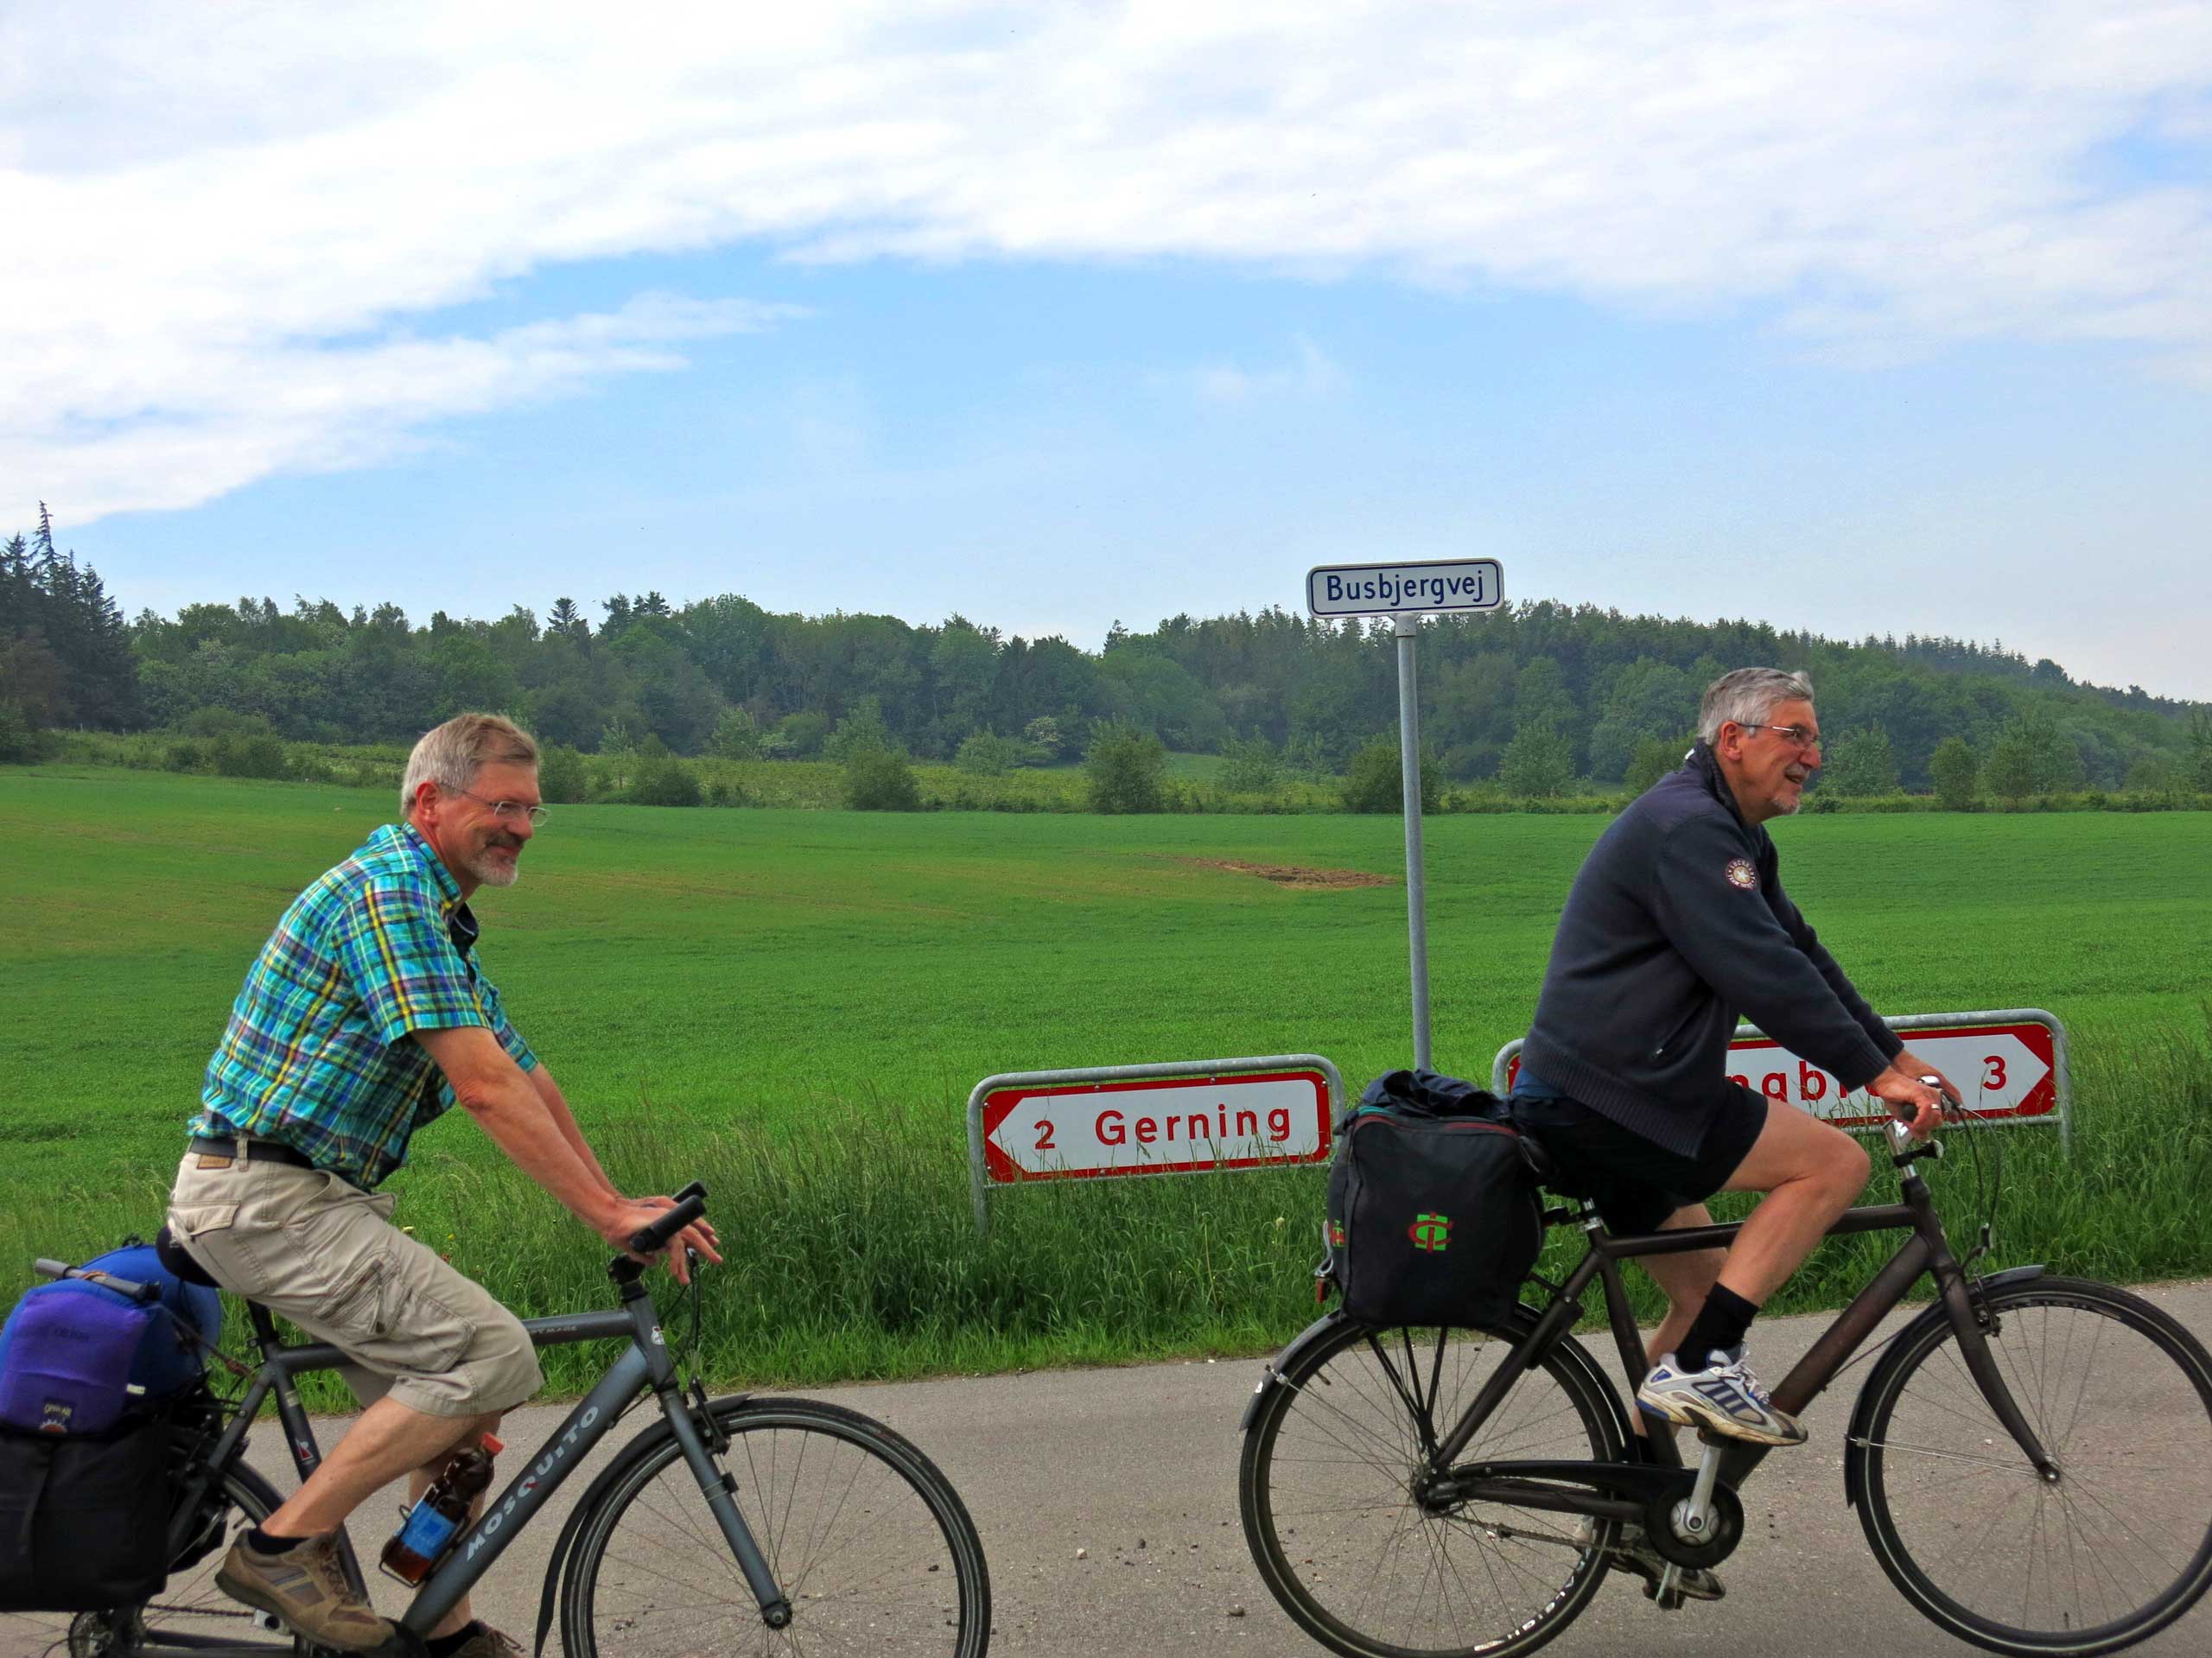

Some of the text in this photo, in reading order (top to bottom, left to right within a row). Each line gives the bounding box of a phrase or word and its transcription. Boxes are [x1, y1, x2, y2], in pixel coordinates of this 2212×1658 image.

[1326, 569, 1484, 607] Busbjergvej
[1983, 1055, 2007, 1090] 3
[1033, 1104, 1290, 1149] 2 Gerning
[467, 1406, 599, 1562] MOSQUITO
